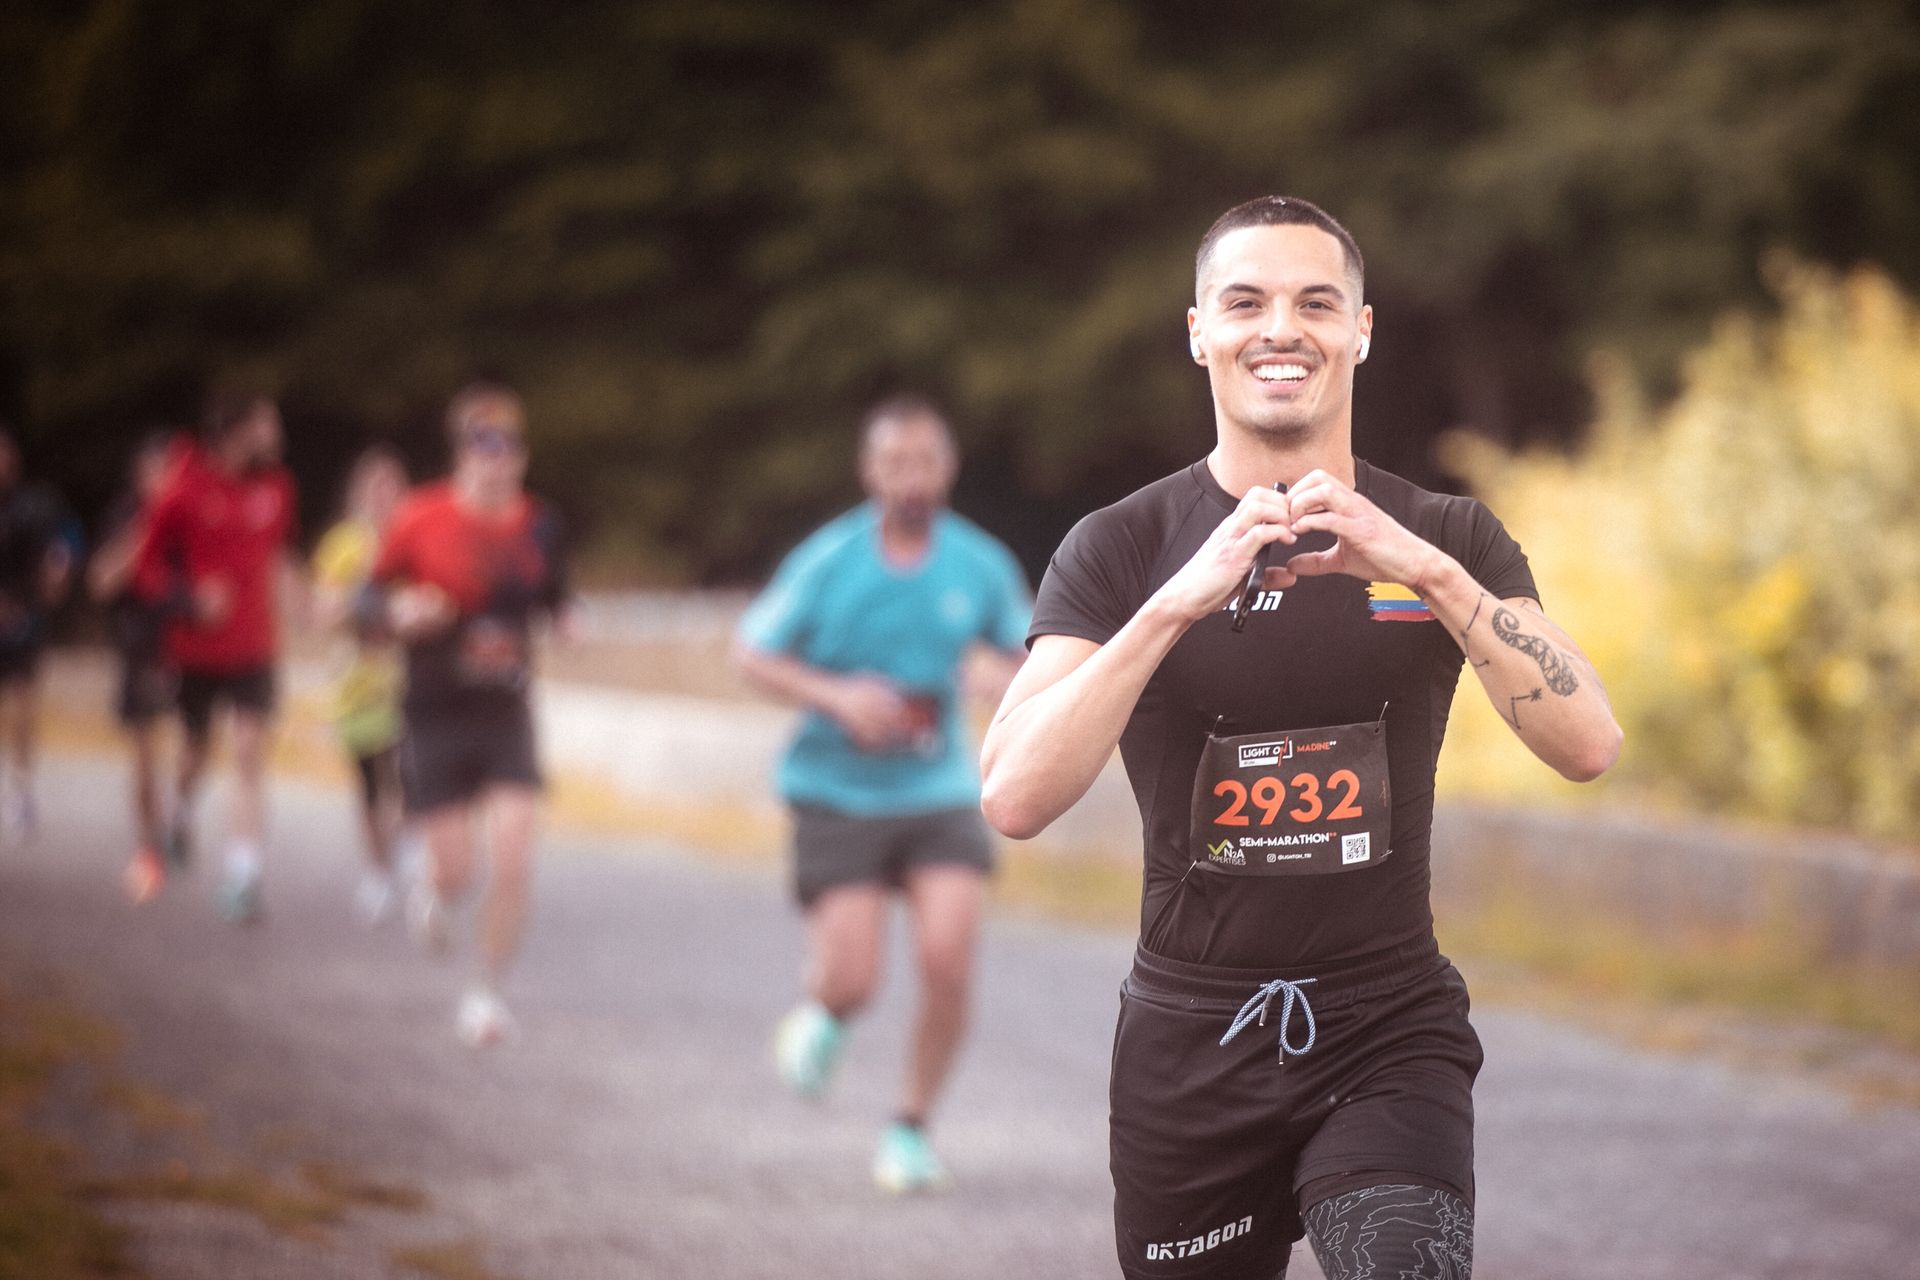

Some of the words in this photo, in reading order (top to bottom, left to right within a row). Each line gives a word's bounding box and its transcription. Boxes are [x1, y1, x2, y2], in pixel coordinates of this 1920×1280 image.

[1243, 746, 1270, 758] LIGHT
[1296, 741, 1331, 753] MADINE
[1213, 768, 1363, 827] 2932
[1239, 832, 1330, 847] SEMI-MARATHON
[1208, 853, 1247, 866] EXPERTISES
[1223, 847, 1245, 859] N2A
[1146, 1215, 1253, 1260] OKTAGON
